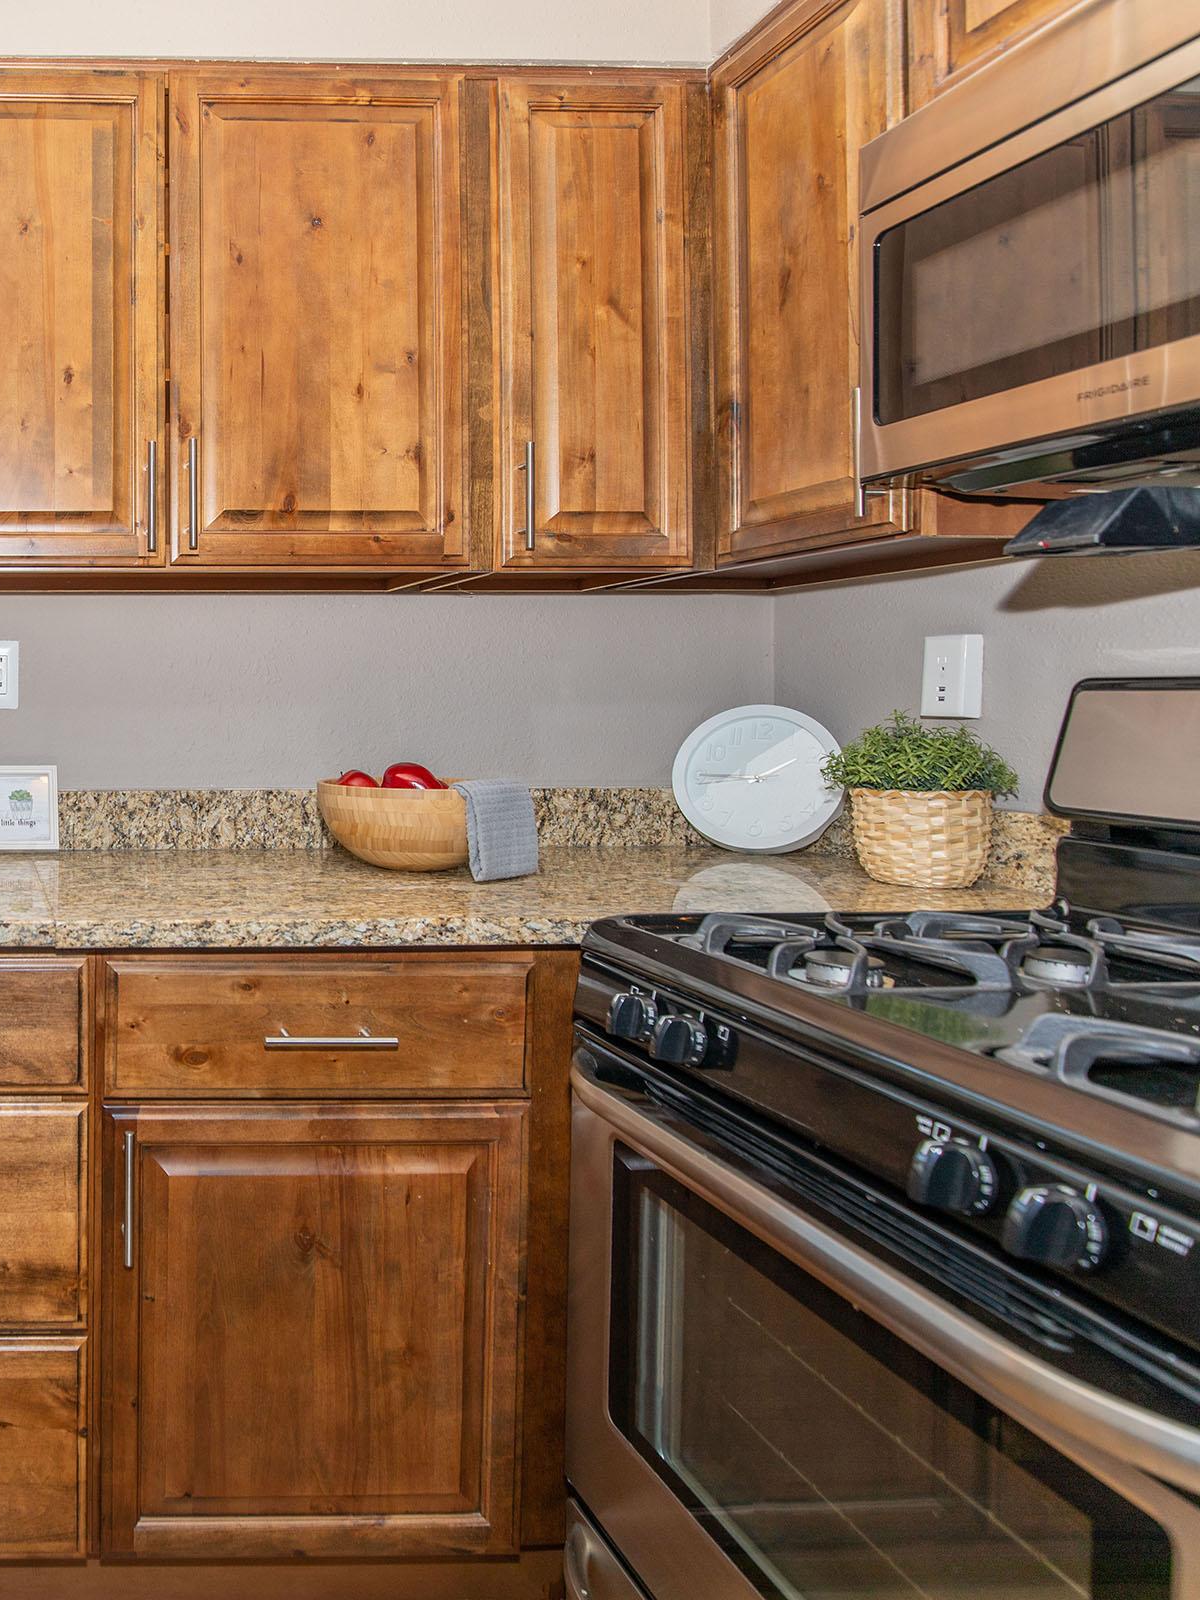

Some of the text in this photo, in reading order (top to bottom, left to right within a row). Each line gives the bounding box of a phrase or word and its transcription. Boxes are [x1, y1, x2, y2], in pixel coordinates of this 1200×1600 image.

[1077, 375, 1151, 402] FRIGIDAIRE
[729, 726, 743, 746] 11
[751, 721, 775, 740] 12
[706, 743, 727, 762] 10
[18, 818, 36, 828] things
[720, 808, 735, 828] 7
[745, 818, 763, 837] 6
